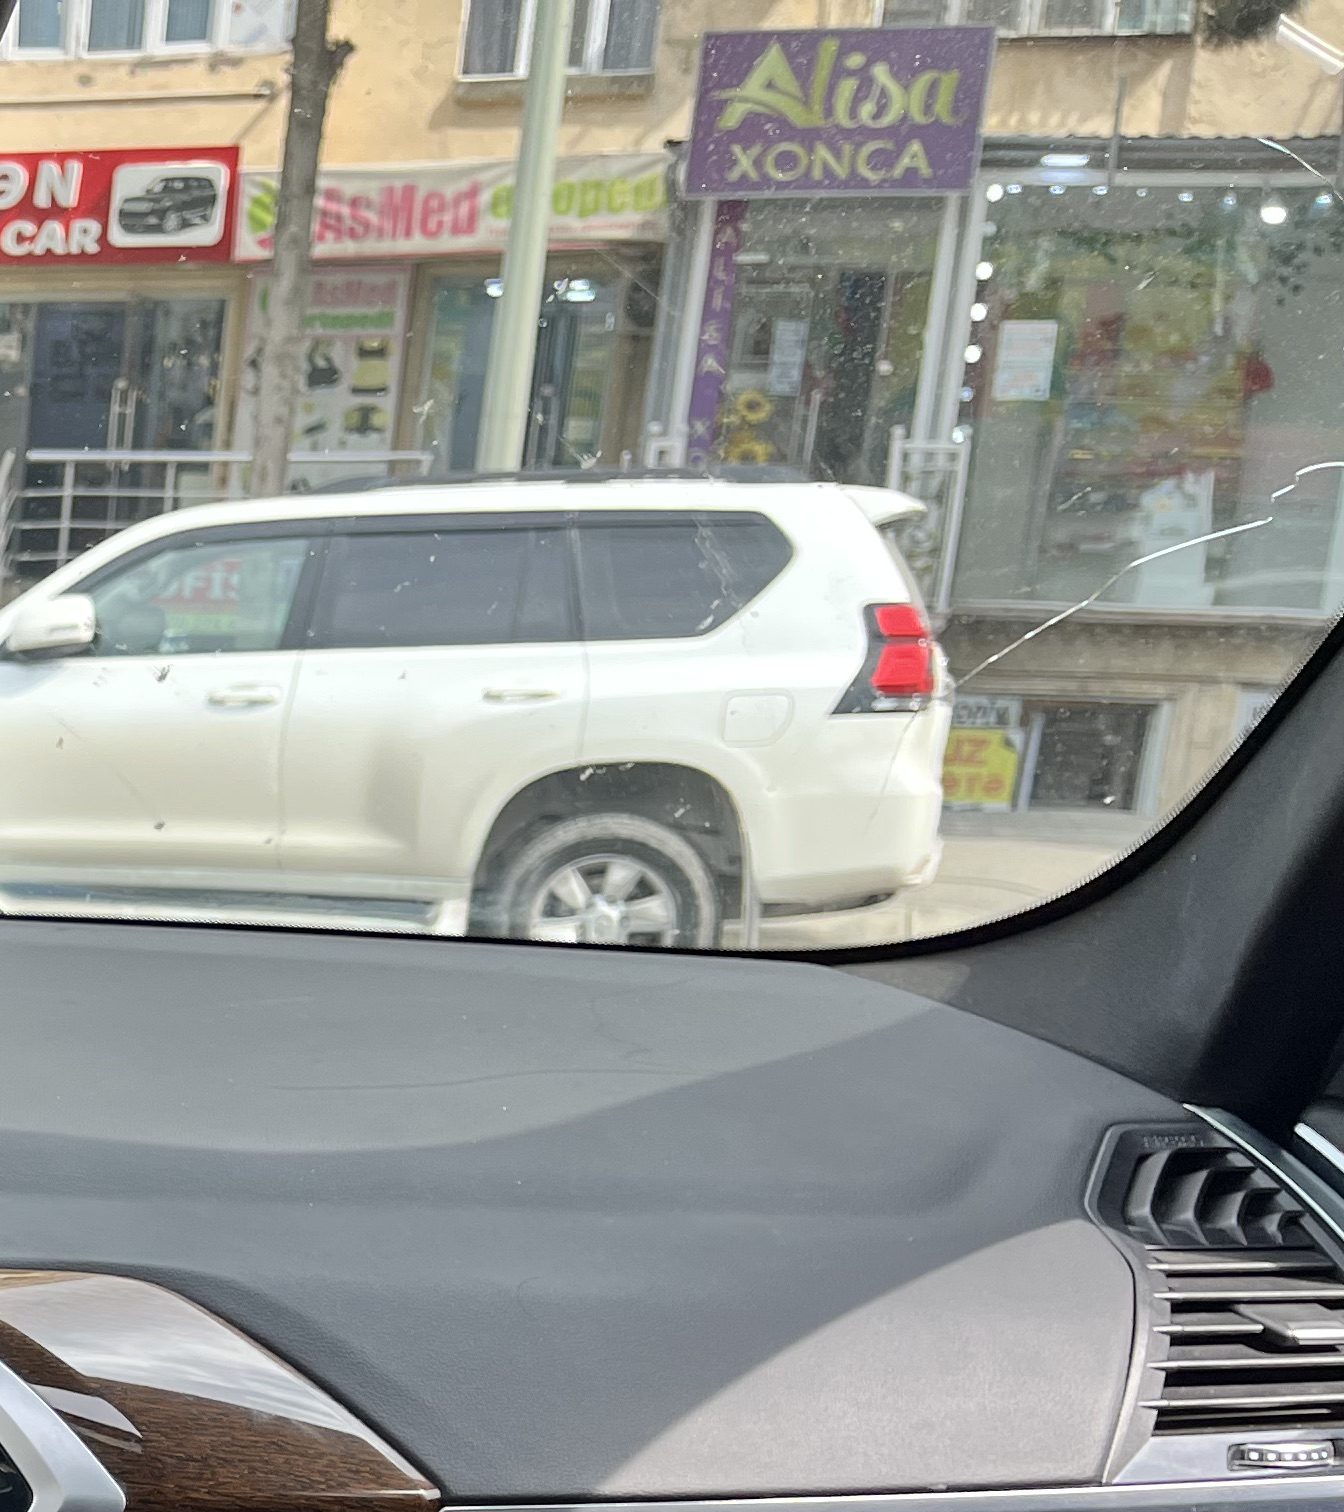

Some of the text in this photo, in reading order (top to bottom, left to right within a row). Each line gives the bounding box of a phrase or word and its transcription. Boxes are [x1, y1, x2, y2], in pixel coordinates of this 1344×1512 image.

[715, 35, 961, 130] Alisa
[726, 140, 932, 182] XONÇA
[0, 219, 102, 255] CAR
